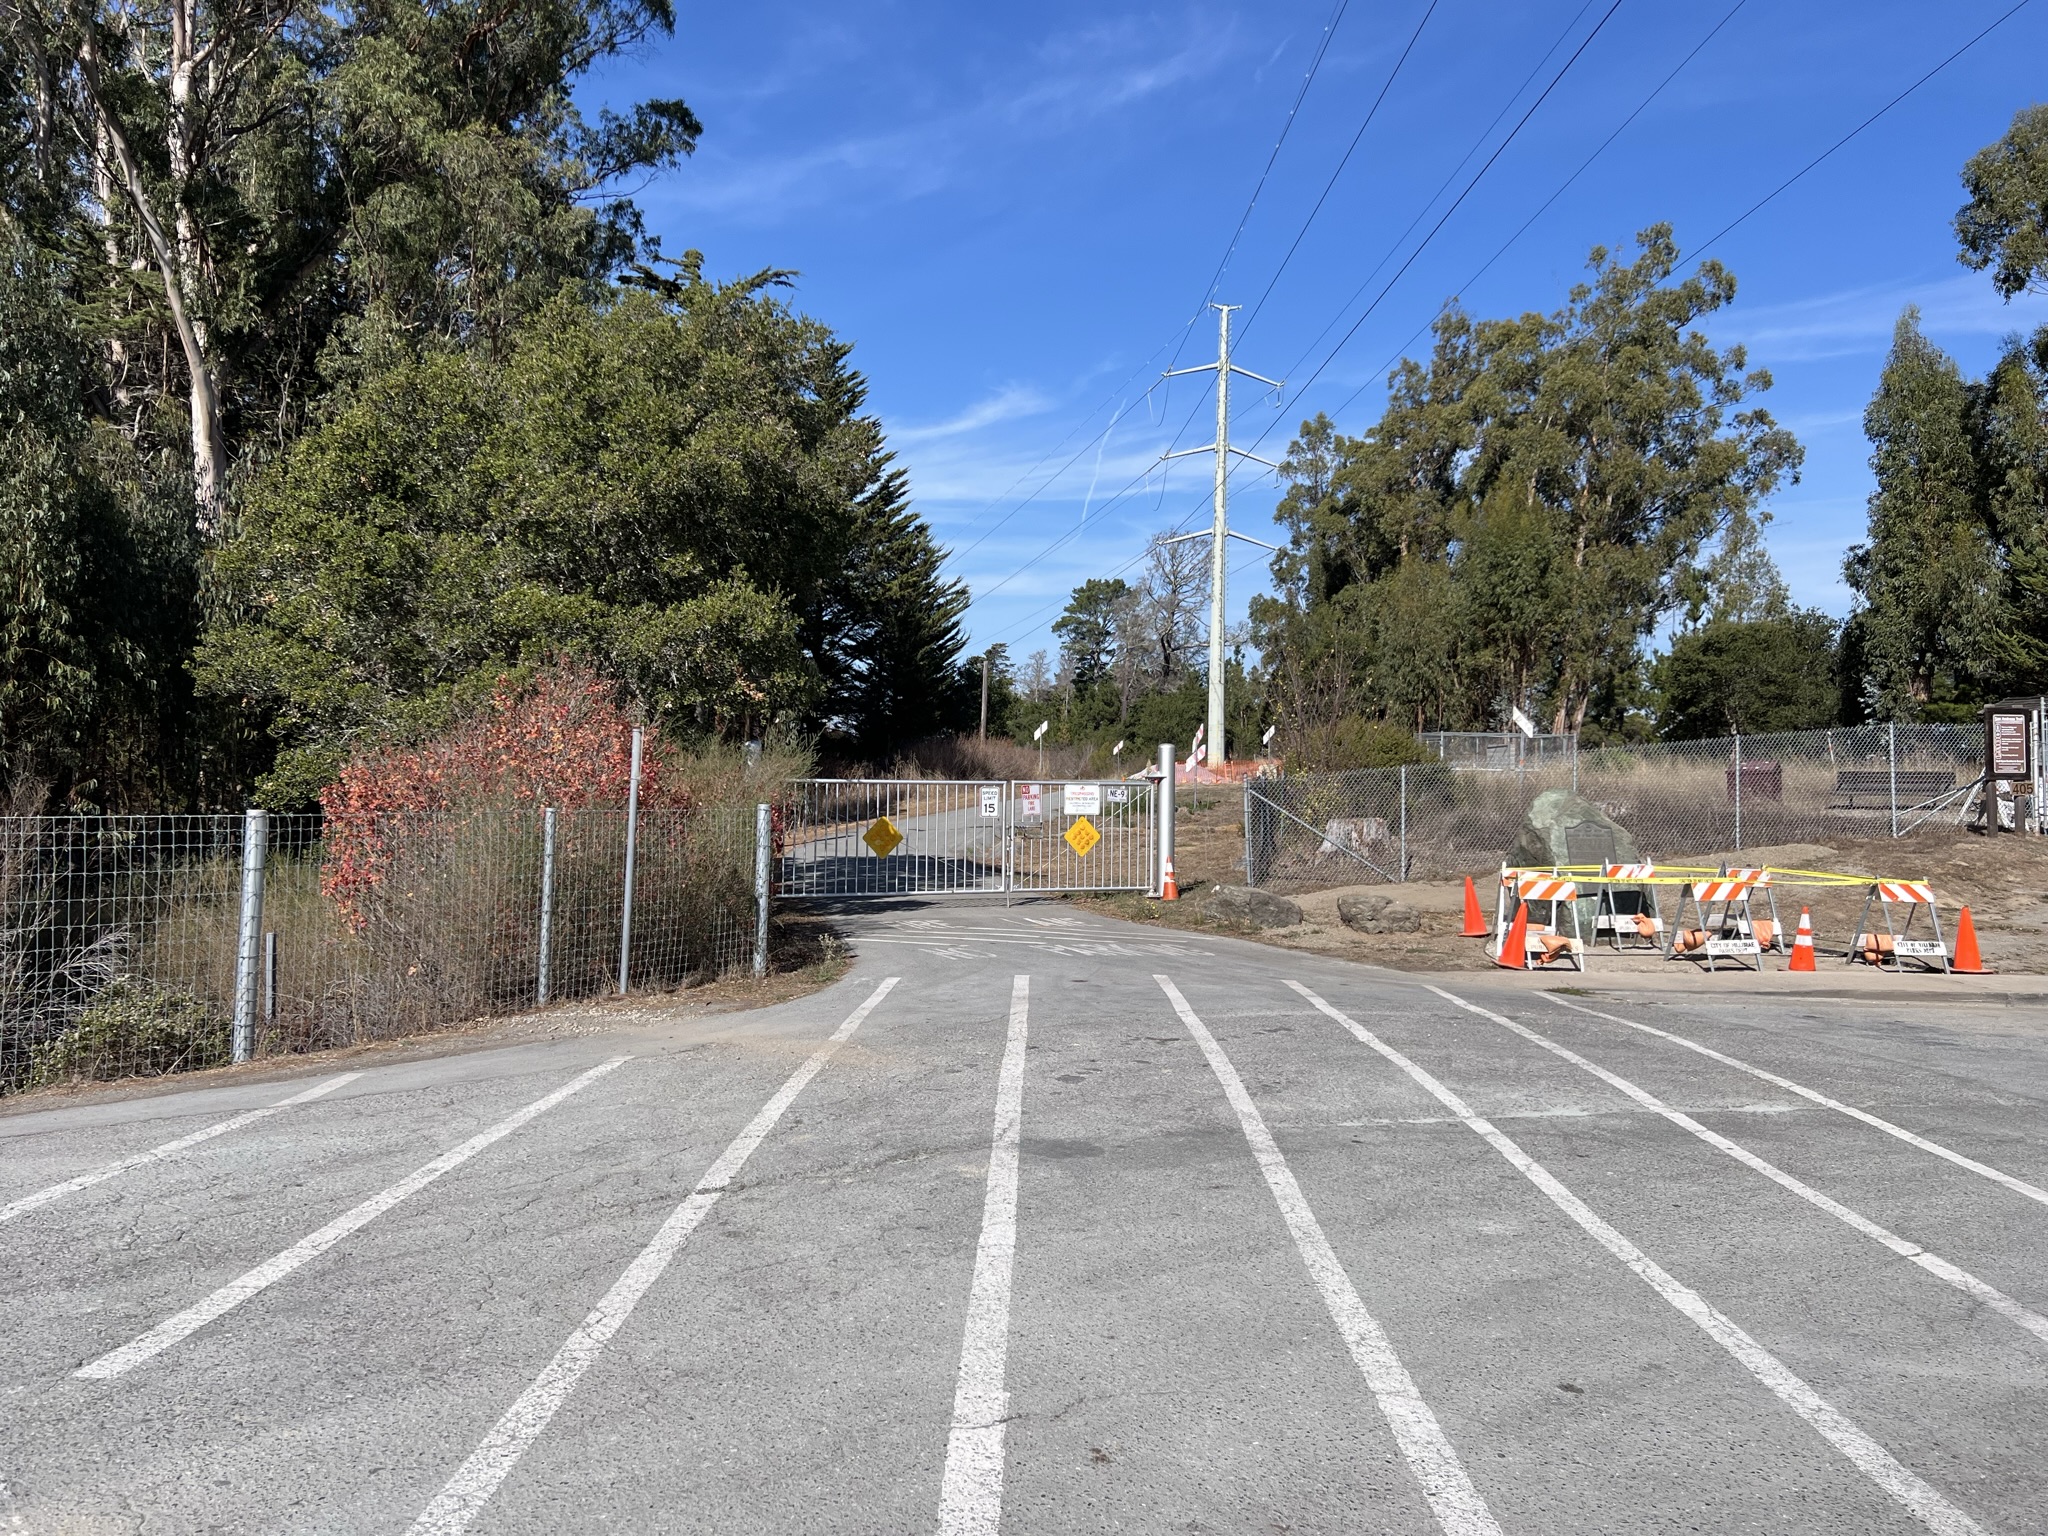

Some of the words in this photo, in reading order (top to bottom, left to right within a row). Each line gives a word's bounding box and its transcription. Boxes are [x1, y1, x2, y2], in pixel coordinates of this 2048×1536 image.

[2013, 784, 2033, 794] 405
[1110, 790, 1125, 798] NE-9
[984, 804, 996, 813] 15
